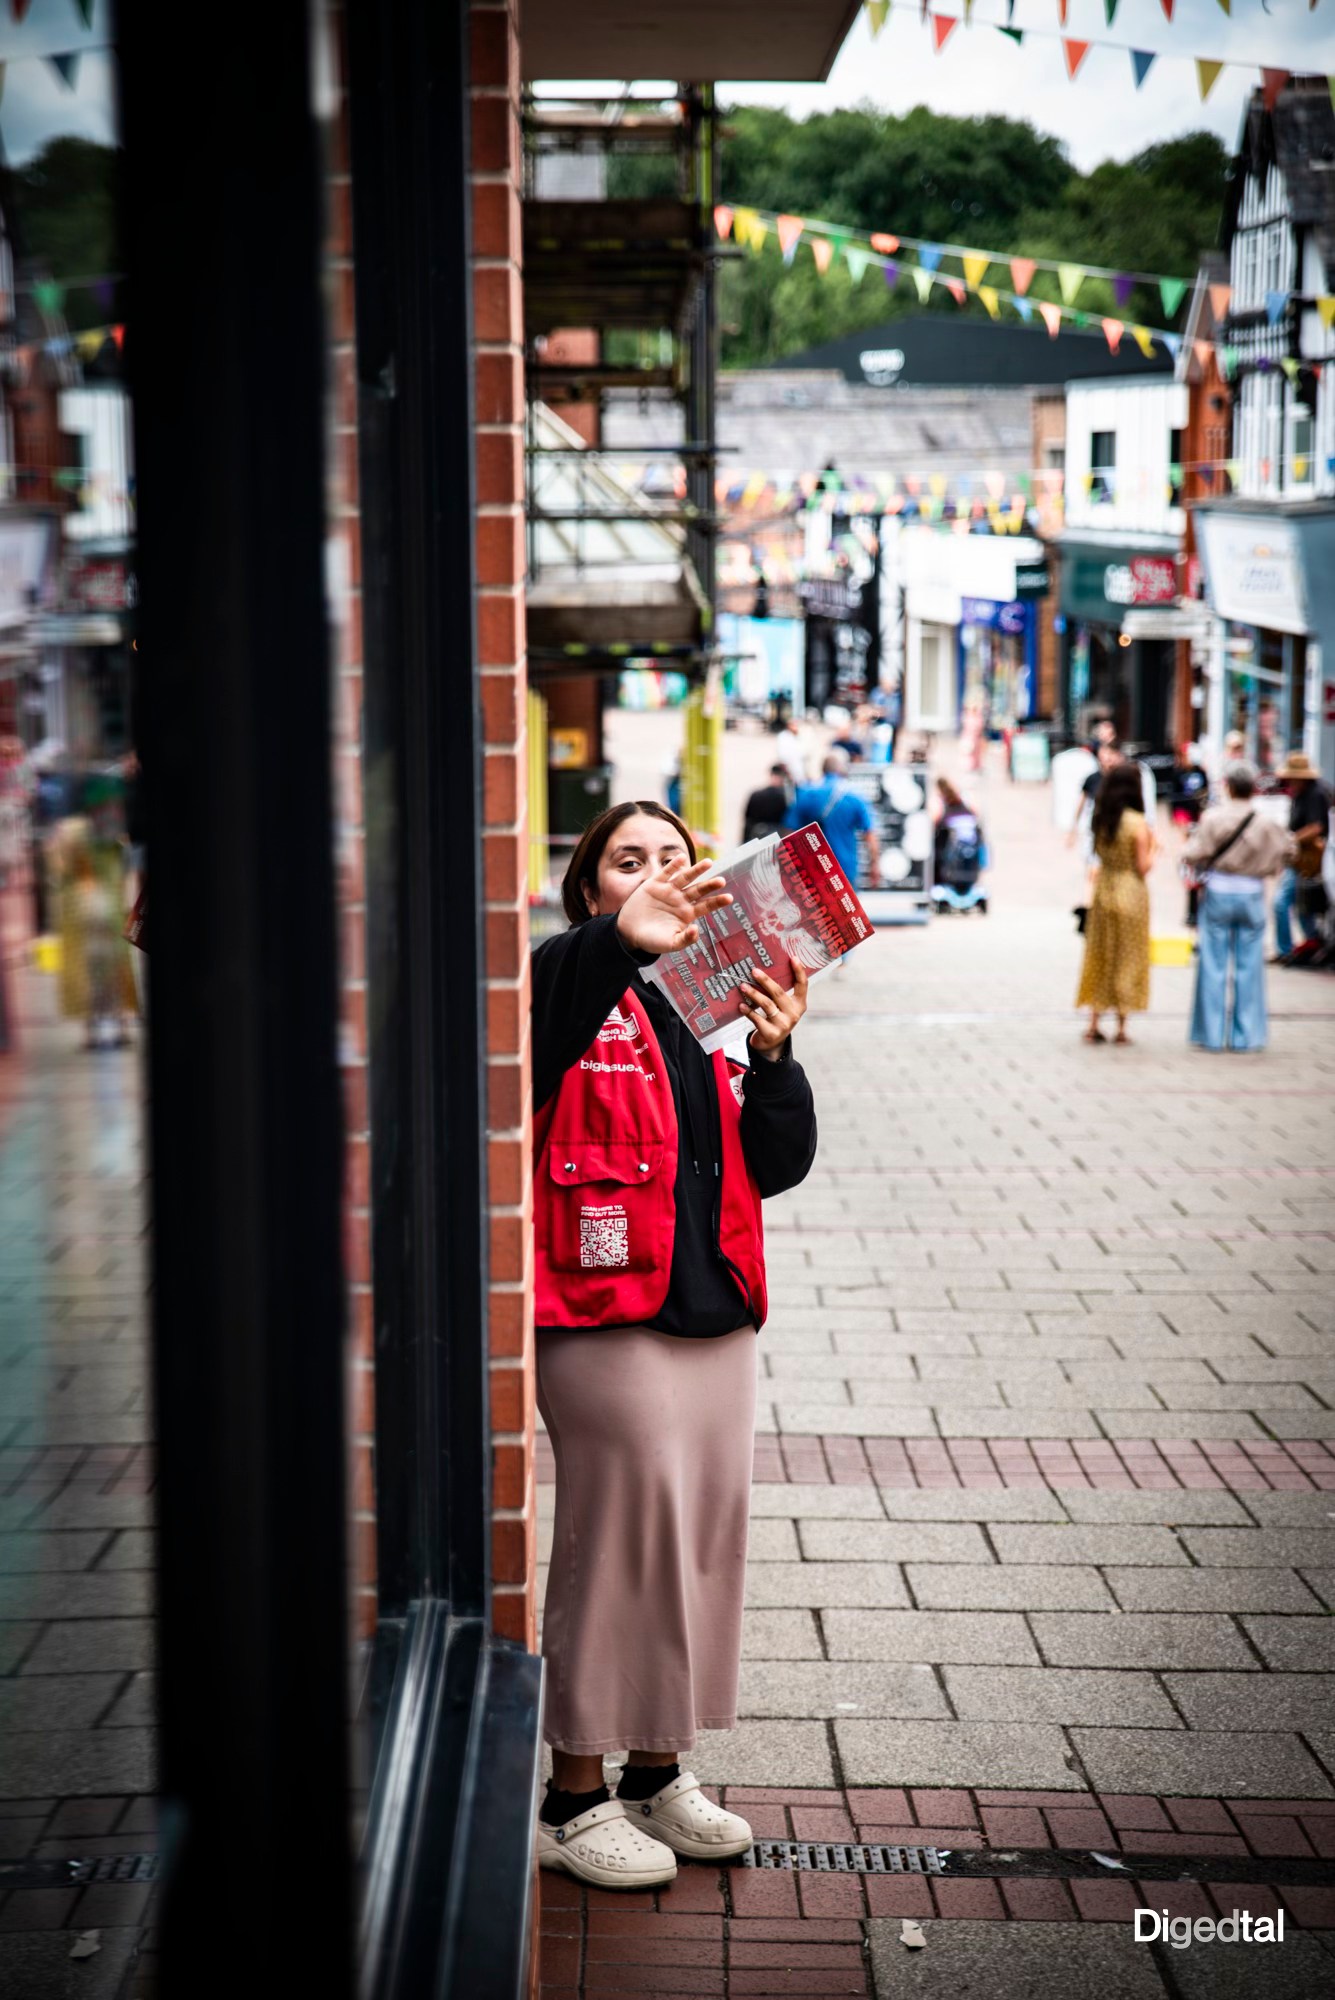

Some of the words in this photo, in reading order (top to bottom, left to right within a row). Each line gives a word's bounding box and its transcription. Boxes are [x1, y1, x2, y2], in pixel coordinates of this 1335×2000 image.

[810, 832, 821, 847] JOHN
[816, 853, 830, 873] ALDRICH
[822, 854, 833, 868] DOUG
[833, 874, 844, 889] DAVID
[774, 841, 802, 874] THE
[790, 868, 822, 909] DEAD
[809, 904, 849, 959] DAISIES
[843, 892, 856, 912] MICHAEL
[731, 901, 744, 918] UK
[739, 916, 758, 942] TOUR
[753, 941, 773, 968] 2025
[856, 916, 867, 933] TOMMY
[676, 961, 696, 987] REBELS
[578, 1844, 627, 1869] crocs
